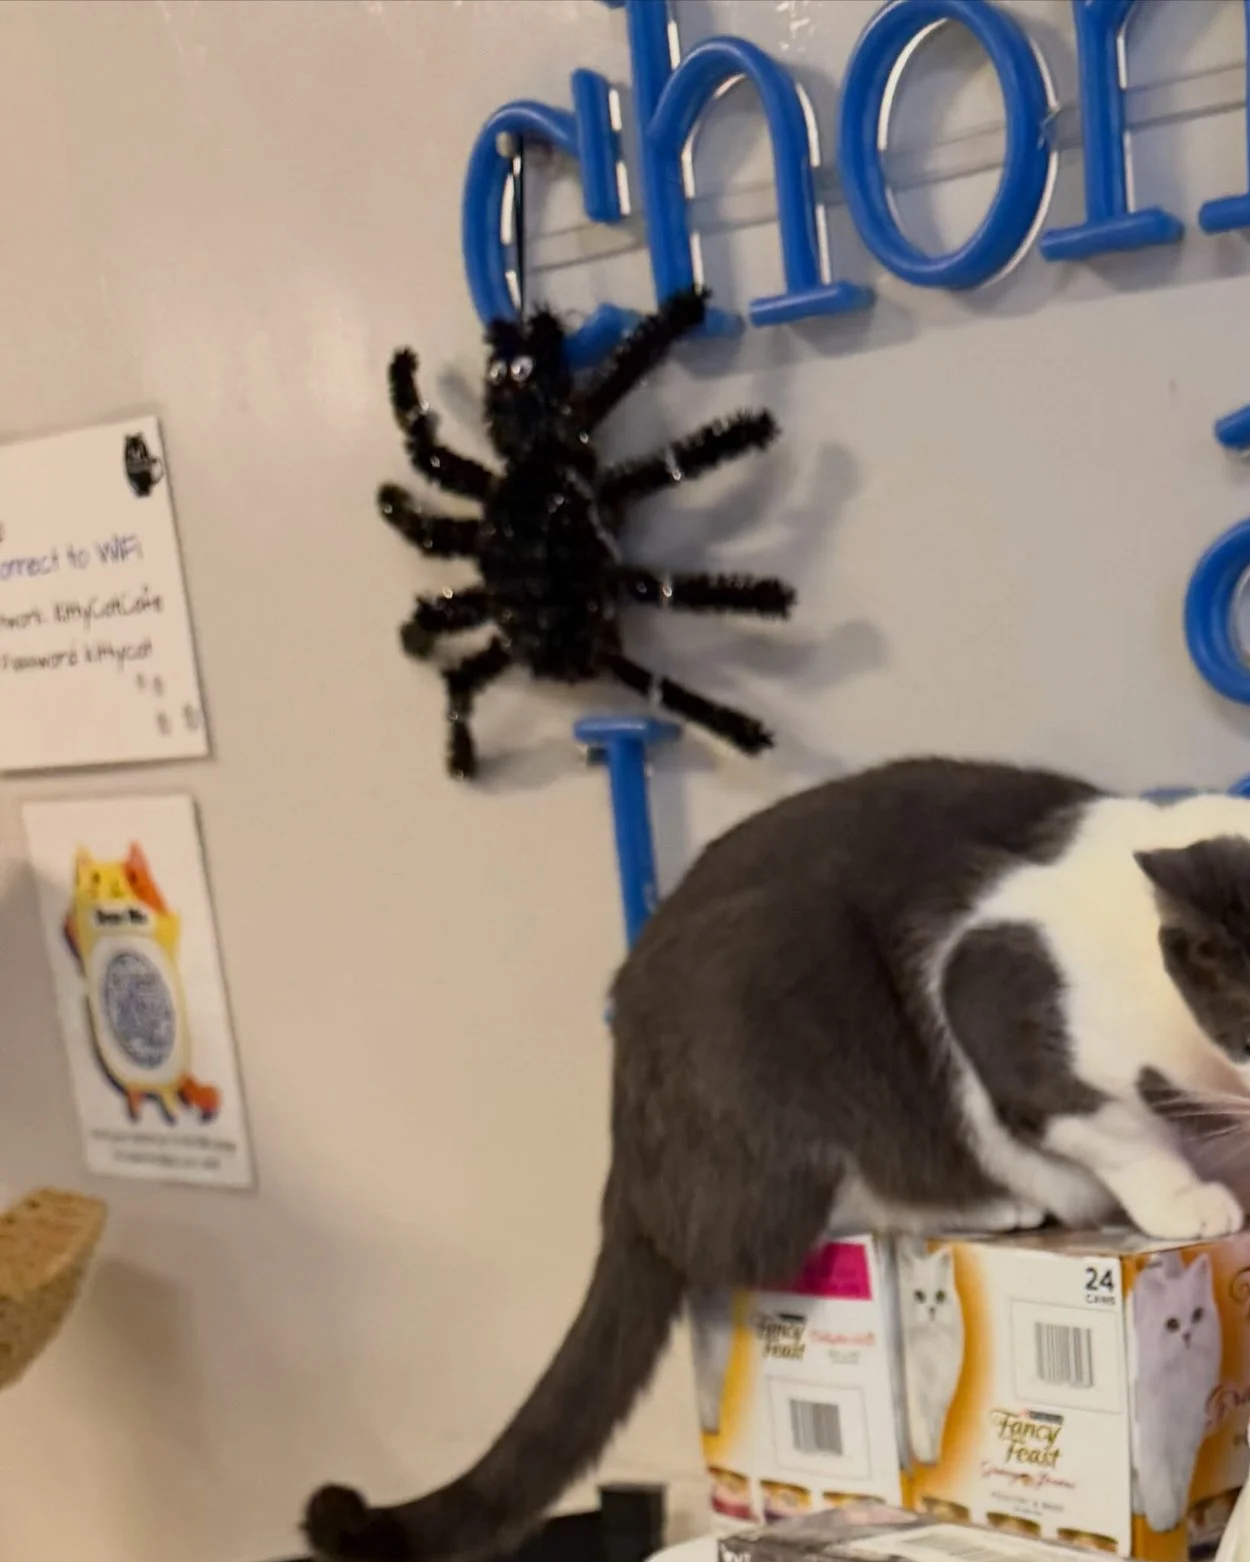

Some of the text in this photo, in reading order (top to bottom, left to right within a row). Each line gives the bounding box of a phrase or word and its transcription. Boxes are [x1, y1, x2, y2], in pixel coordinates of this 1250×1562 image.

[67, 543, 90, 569] to
[1085, 1267, 1114, 1292] 24
[990, 1408, 1062, 1449] Fancy
[1001, 1438, 1060, 1469] Feast
